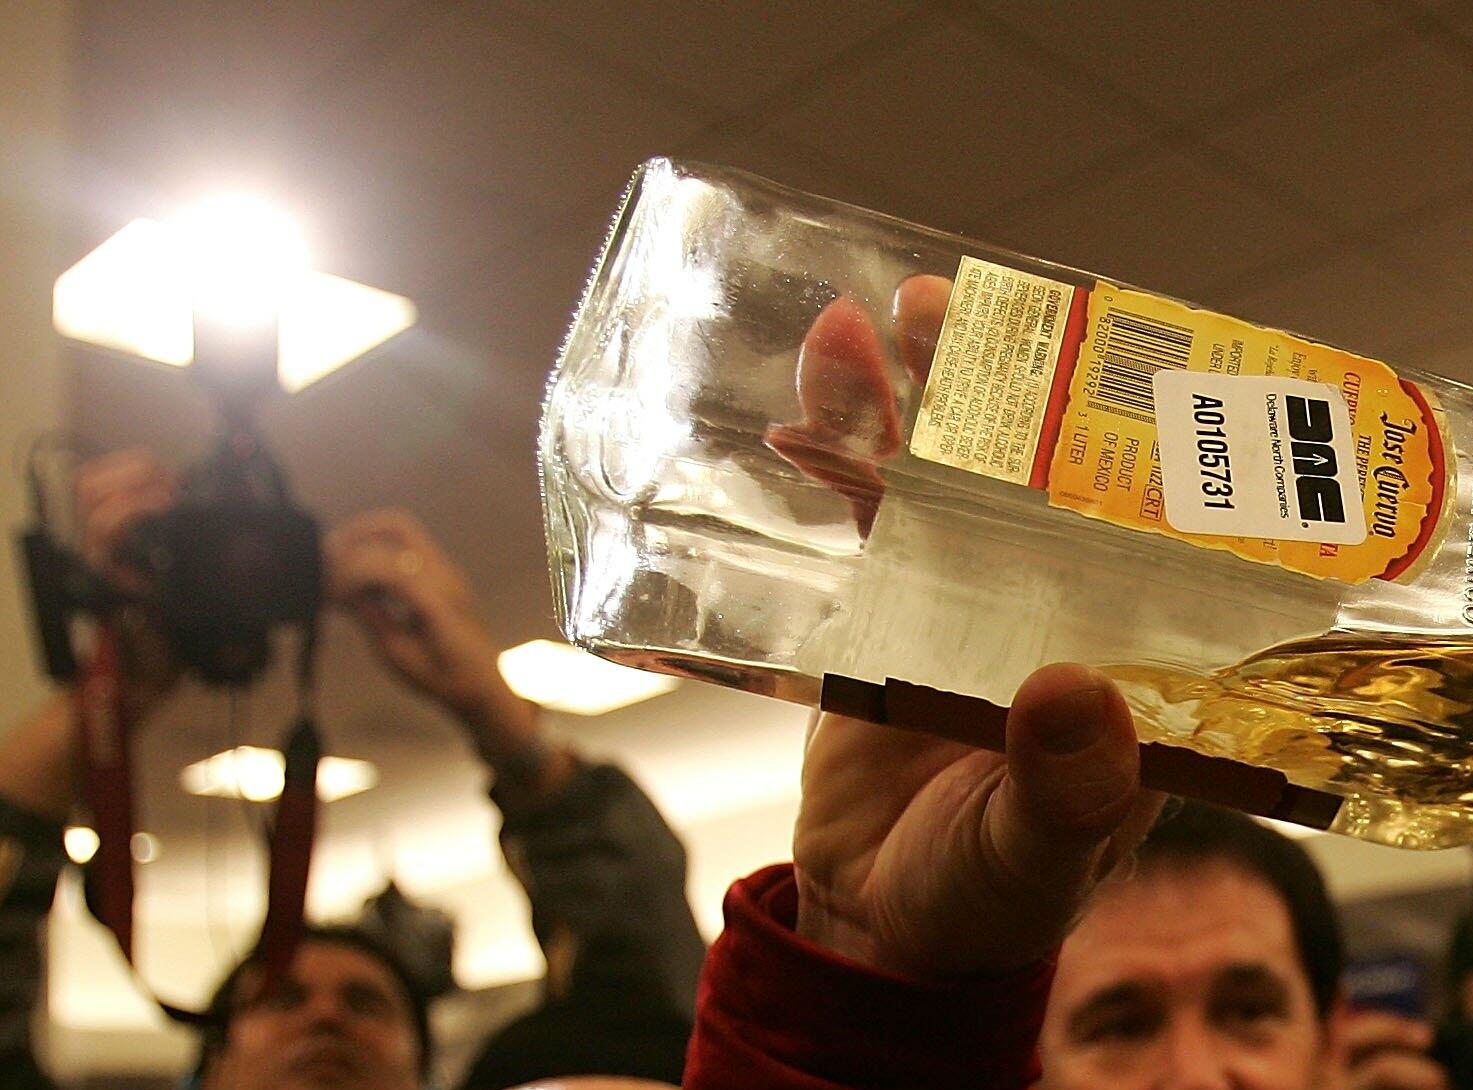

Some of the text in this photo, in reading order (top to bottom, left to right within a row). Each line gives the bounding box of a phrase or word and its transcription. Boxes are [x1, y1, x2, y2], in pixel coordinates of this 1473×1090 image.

[1040, 289, 1061, 338] GOVERNMENT
[1091, 316, 1111, 353] 82000
[1081, 359, 1101, 395] 19292
[1265, 393, 1280, 437] Delaware
[1067, 432, 1088, 465] LITER
[1092, 431, 1119, 492] OF MEXICO
[1114, 437, 1141, 491] PRODUCT
[1191, 393, 1234, 510] A0105731
[1271, 438, 1283, 464] North
[1356, 433, 1372, 456] THE
[1274, 465, 1290, 518] Companies
[1371, 412, 1418, 538] Jose Cuervo
[1141, 486, 1164, 518] CRT
